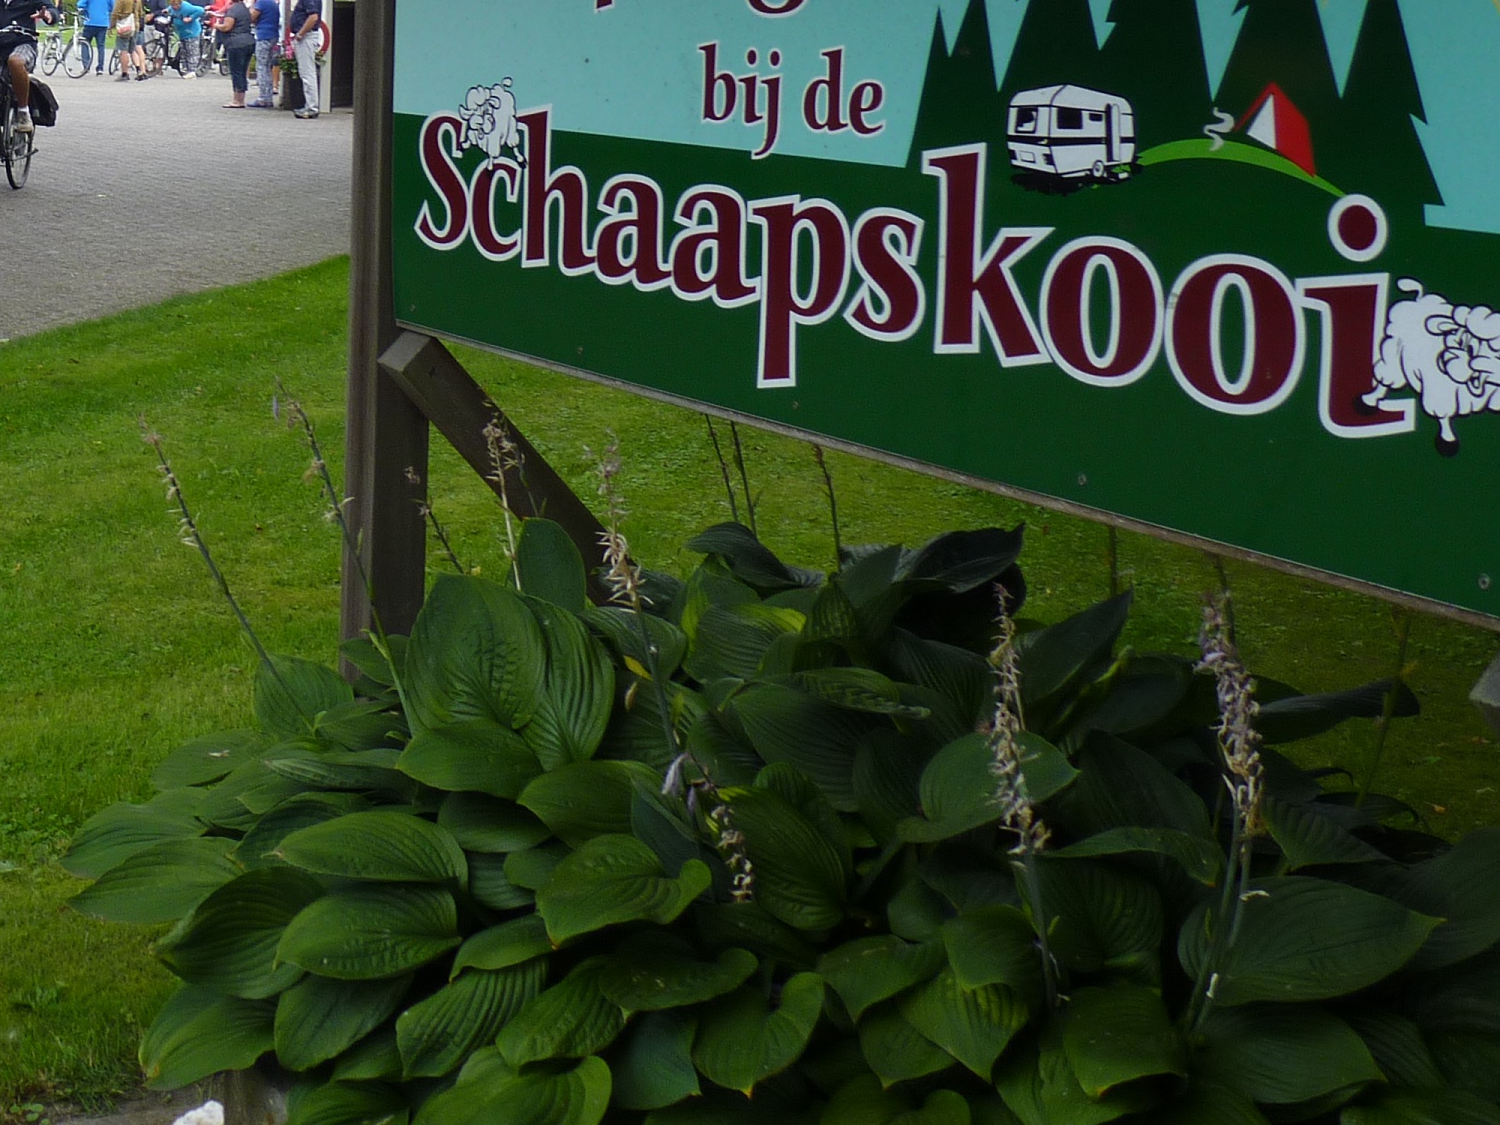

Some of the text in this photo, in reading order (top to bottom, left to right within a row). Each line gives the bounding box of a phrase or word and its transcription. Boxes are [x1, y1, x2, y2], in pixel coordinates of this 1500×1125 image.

[700, 42, 886, 157] bij de
[415, 109, 1417, 439] Schaapskooi
